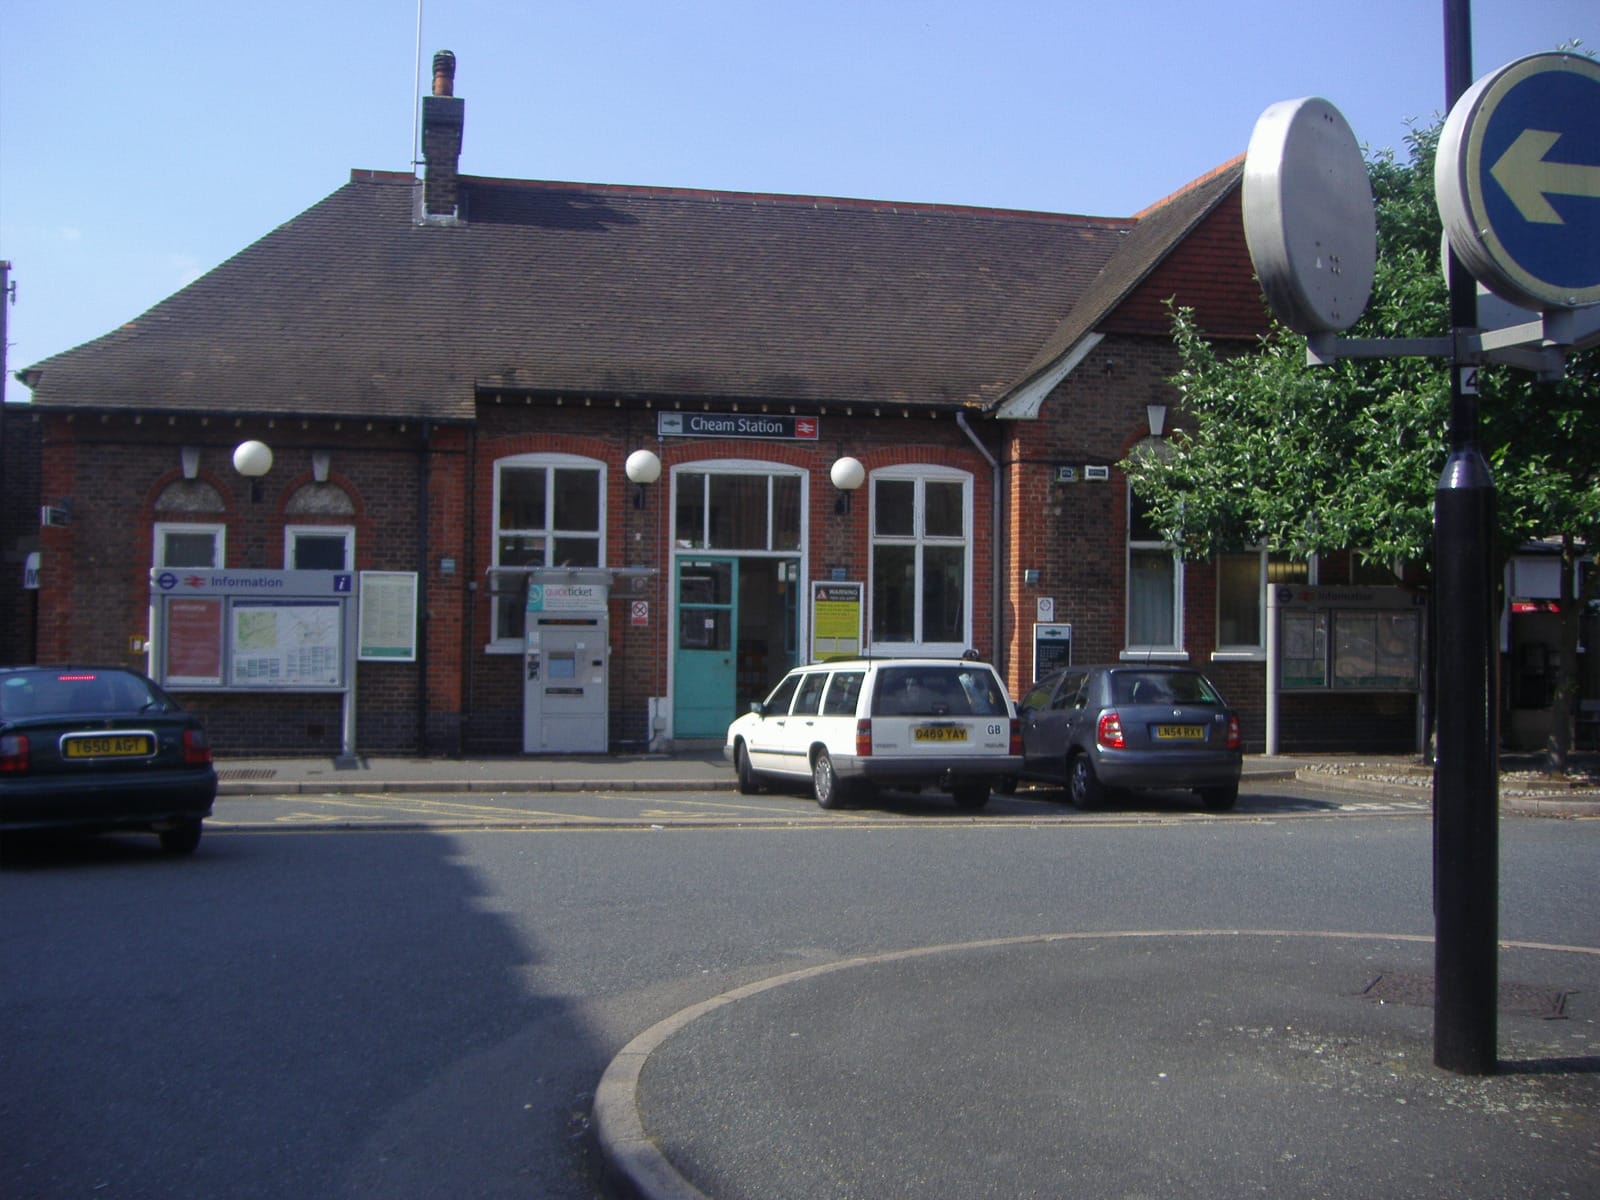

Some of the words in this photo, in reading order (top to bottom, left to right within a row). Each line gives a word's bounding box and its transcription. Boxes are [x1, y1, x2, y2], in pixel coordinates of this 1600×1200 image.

[1465, 369, 1479, 392] 4
[690, 417, 735, 432] Cheam
[738, 418, 783, 434] Station
[211, 576, 283, 588] Information
[946, 729, 966, 739] YAY
[987, 724, 1001, 735] GB
